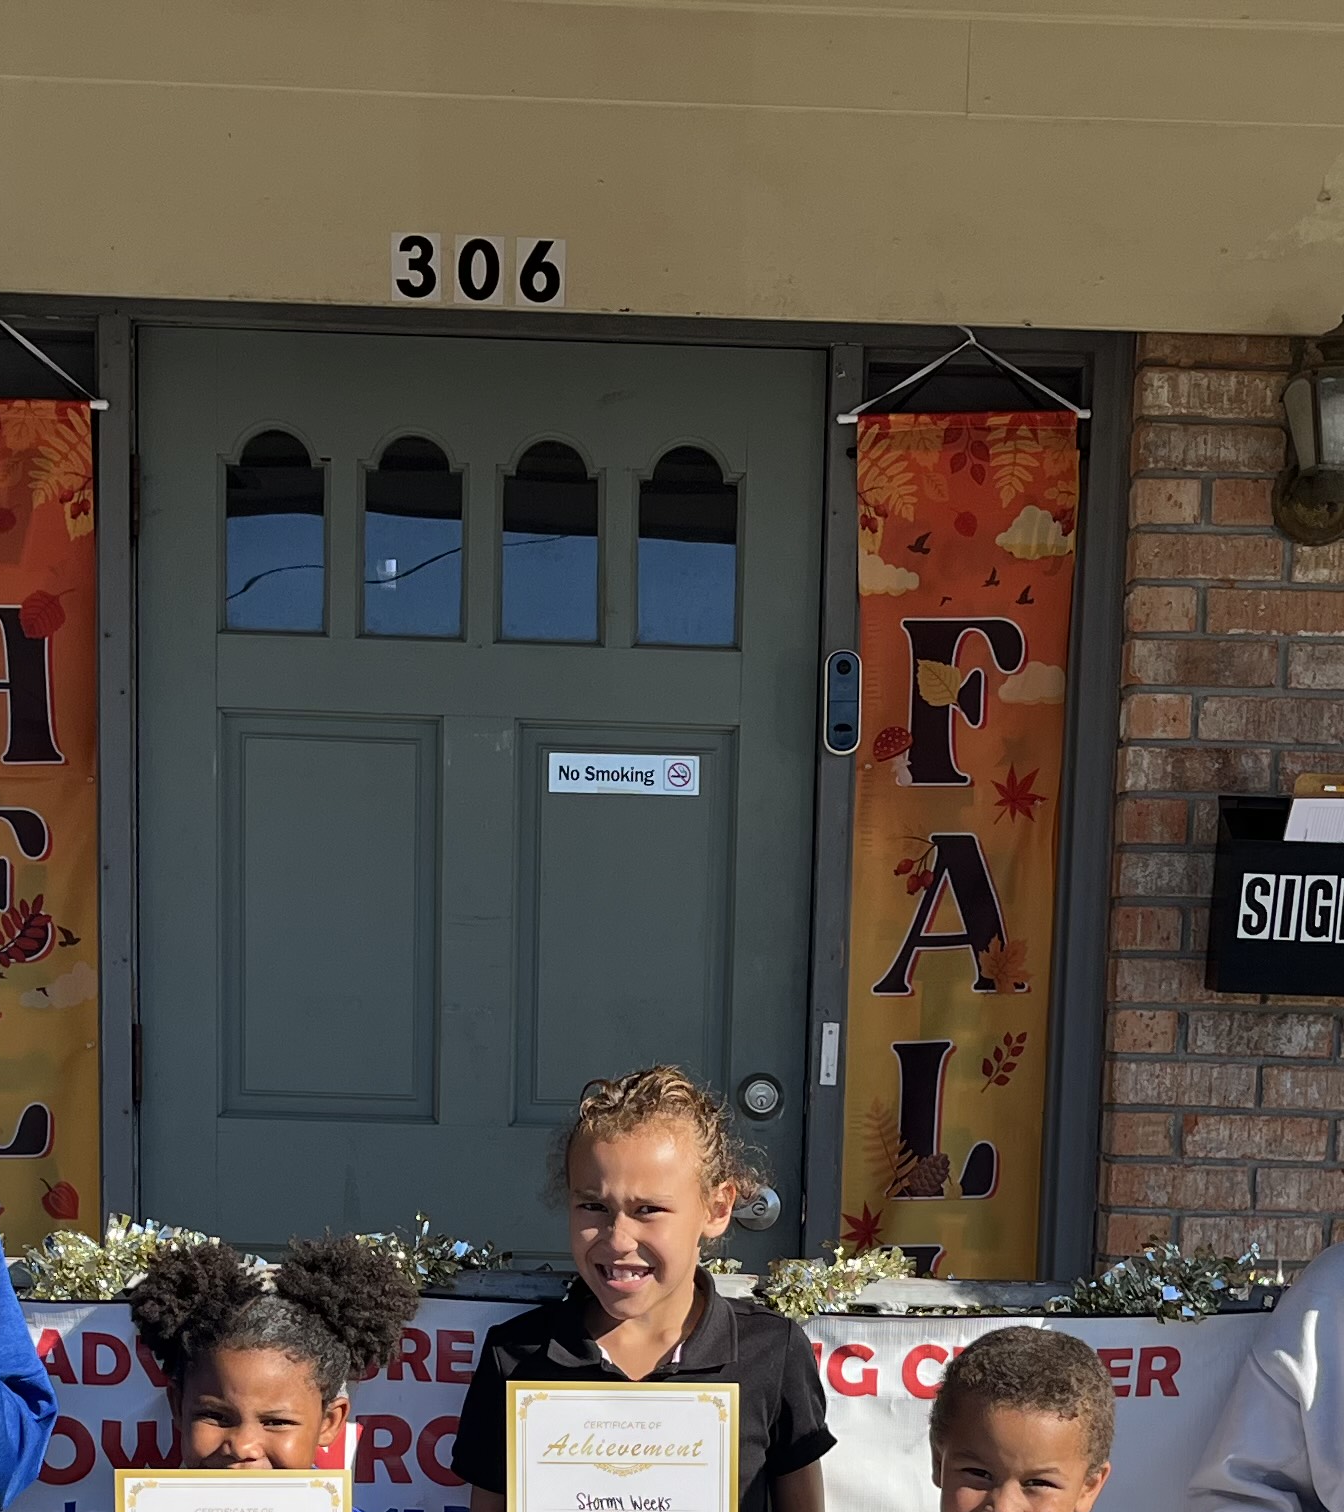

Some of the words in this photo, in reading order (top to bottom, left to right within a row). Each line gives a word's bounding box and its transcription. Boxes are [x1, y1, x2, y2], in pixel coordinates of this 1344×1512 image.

[396, 235, 560, 303] 306
[558, 765, 580, 781] No
[584, 765, 655, 786] Smoking
[583, 1420, 646, 1429] CERTIFICATE
[648, 1421, 662, 1430] OF
[542, 1433, 704, 1457] Achievement
[576, 1492, 625, 1511] Stormy
[629, 1494, 672, 1512] Weeks
